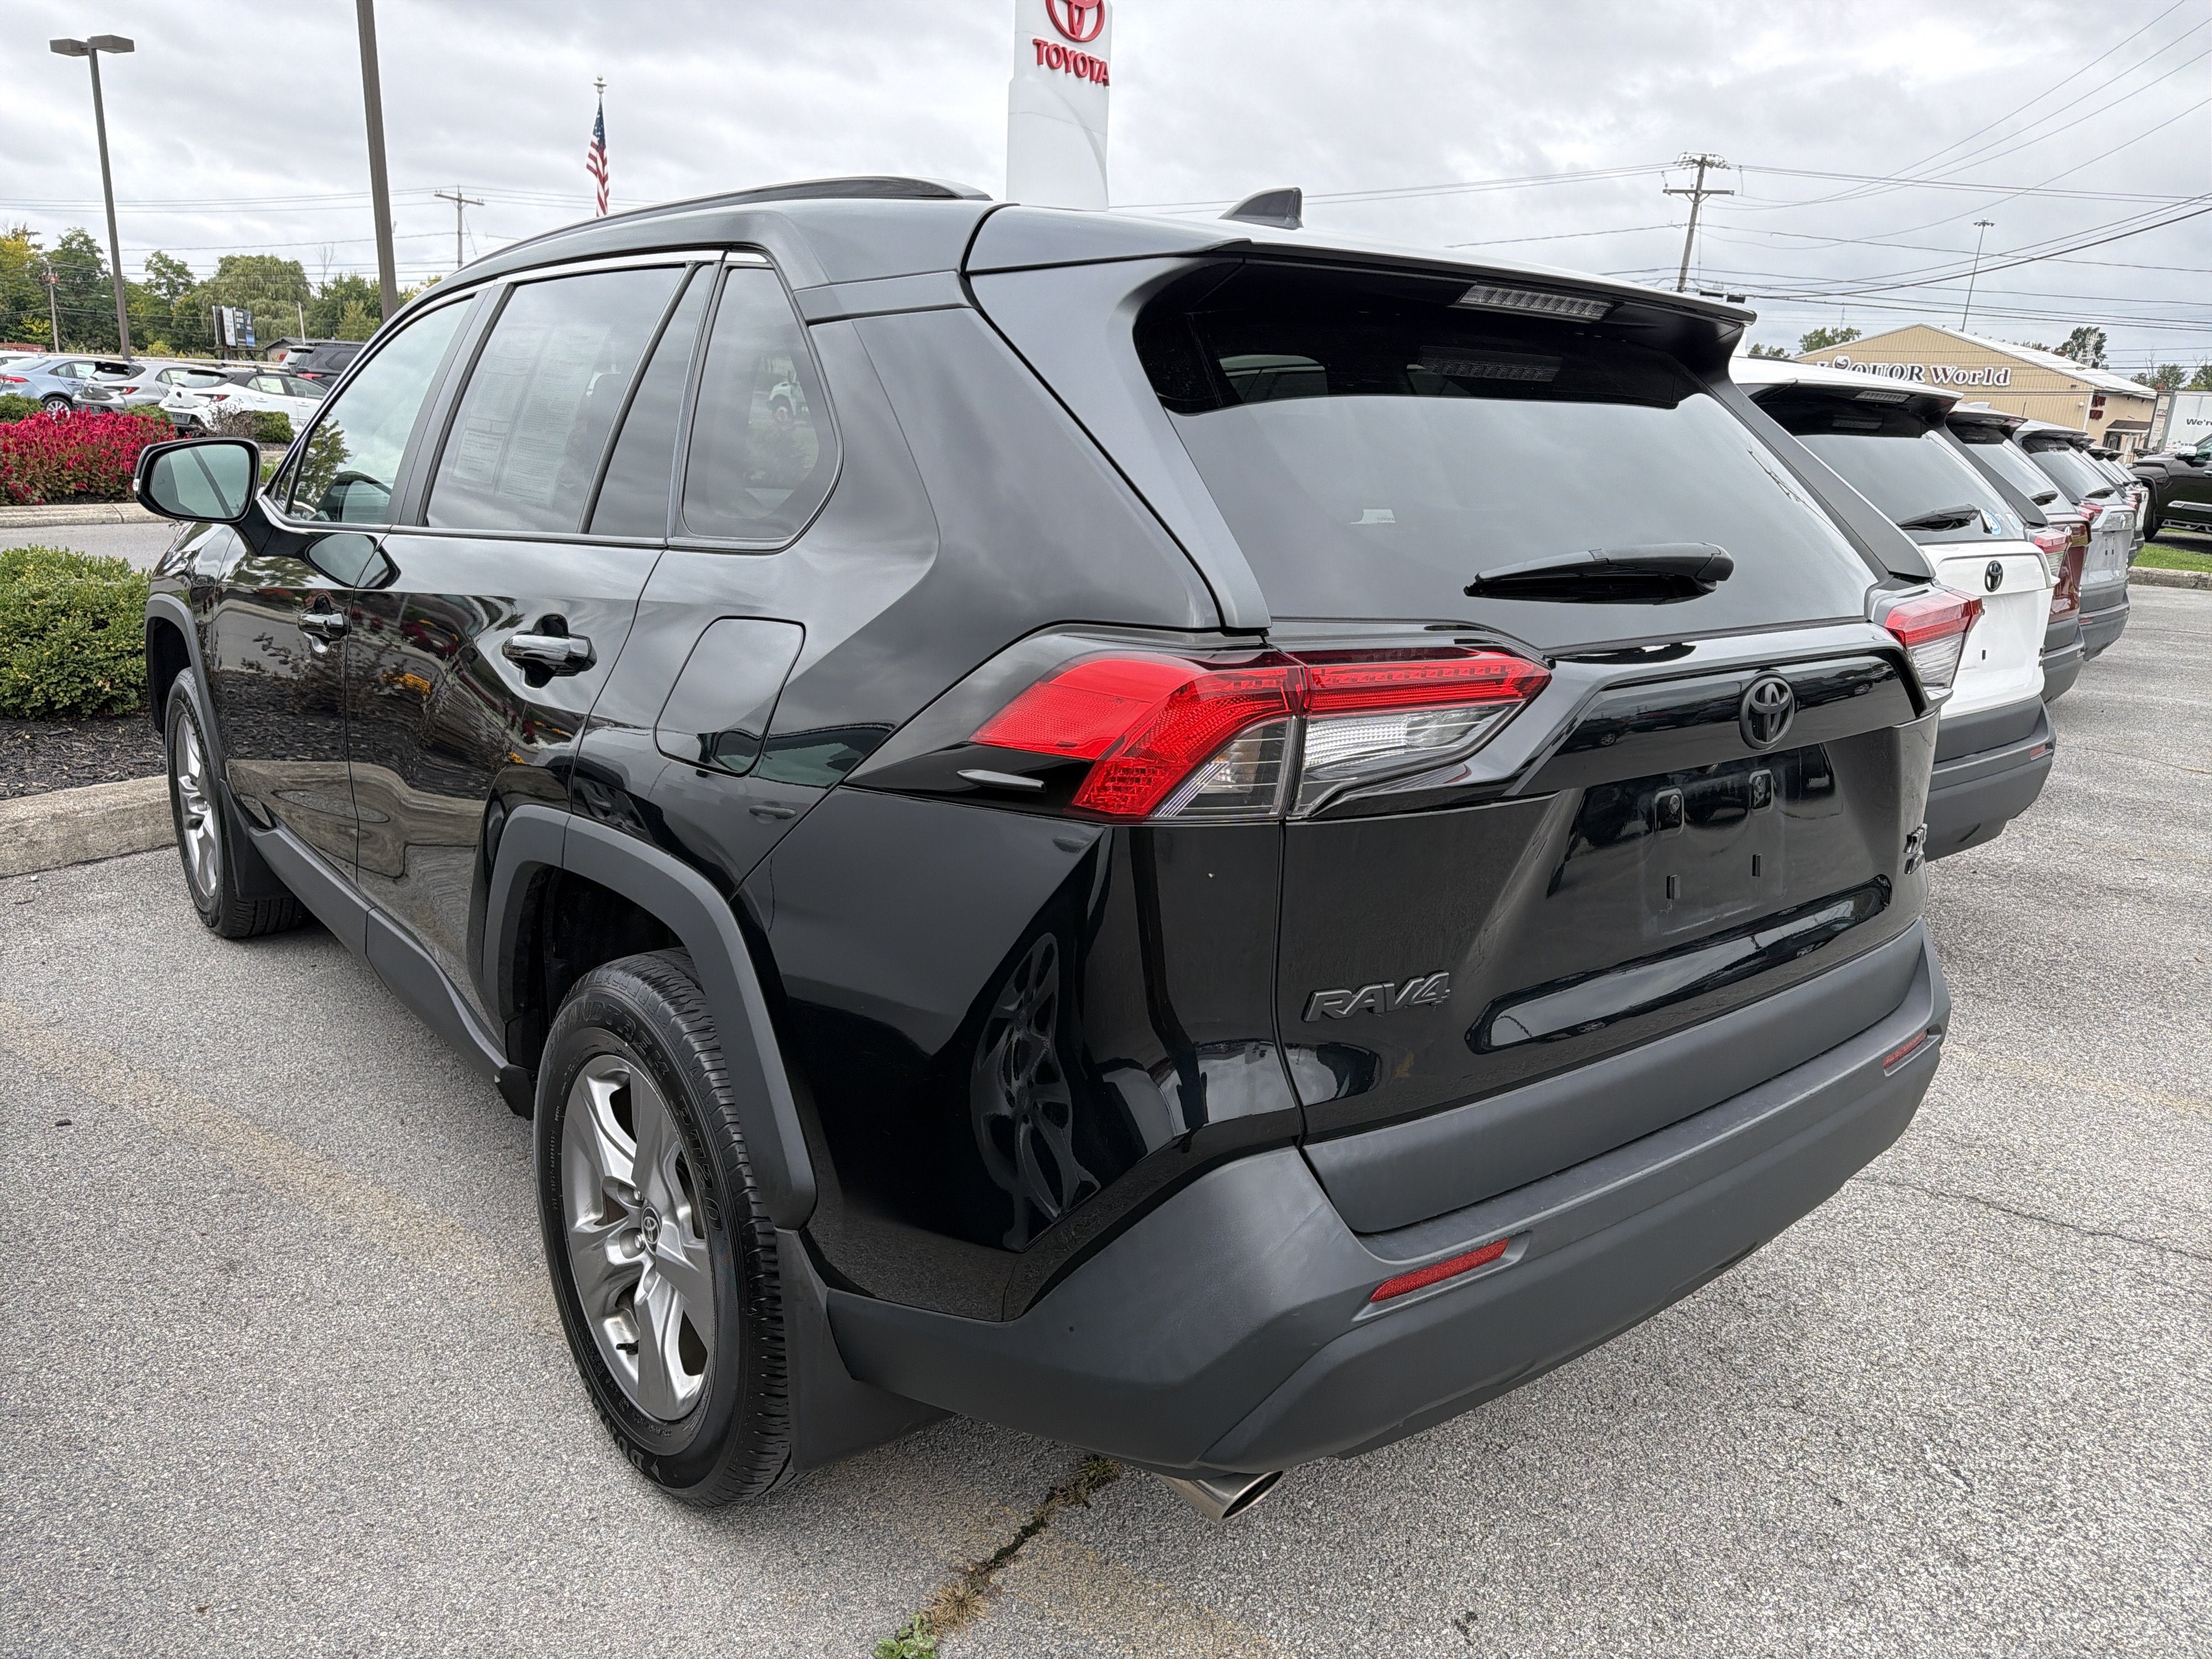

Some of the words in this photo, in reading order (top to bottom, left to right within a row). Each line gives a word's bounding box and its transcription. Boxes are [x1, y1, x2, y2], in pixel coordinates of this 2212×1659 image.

[1032, 38, 1110, 87] TOYOTA
[1817, 356, 1926, 383] UOR
[1931, 366, 2011, 386] World
[1301, 970, 1451, 1022] RAV4
